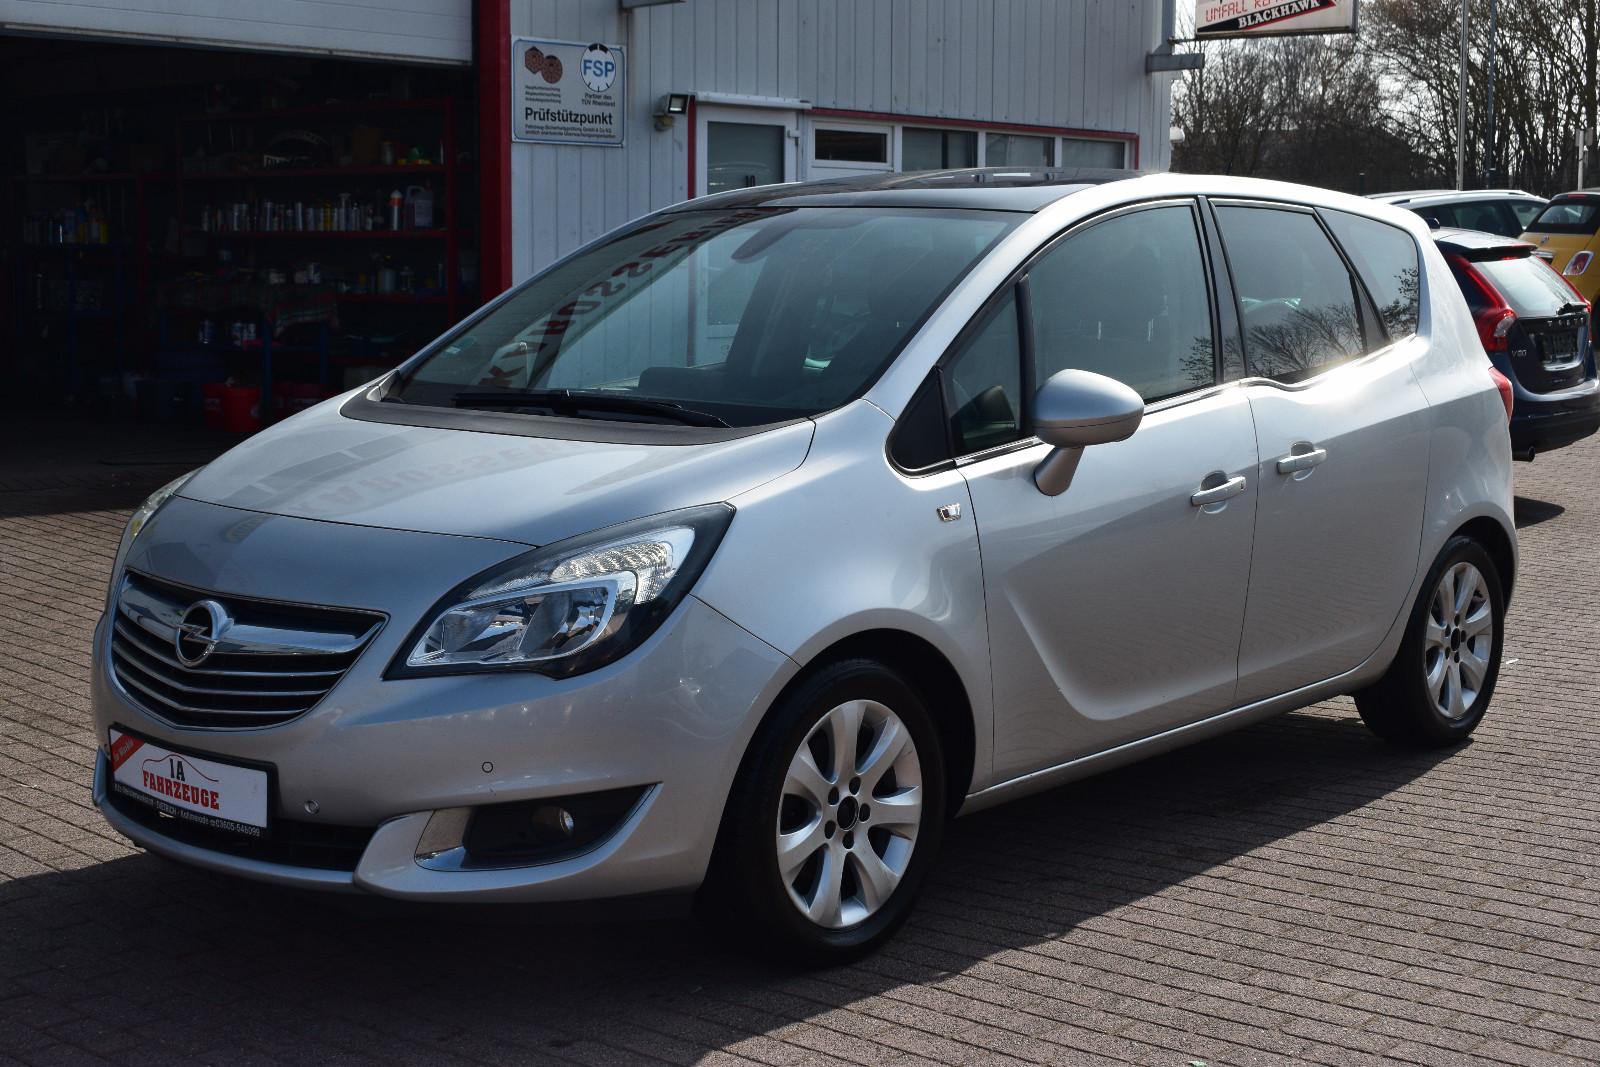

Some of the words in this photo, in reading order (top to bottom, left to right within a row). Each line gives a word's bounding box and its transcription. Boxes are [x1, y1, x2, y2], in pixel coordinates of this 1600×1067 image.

[1205, 0, 1247, 22] UNFALL
[1238, 0, 1321, 28] BLACKHAWK
[583, 60, 615, 77] FSP
[525, 107, 613, 126] Prüfstützpunkt
[142, 770, 220, 810] FAHRZEUGE
